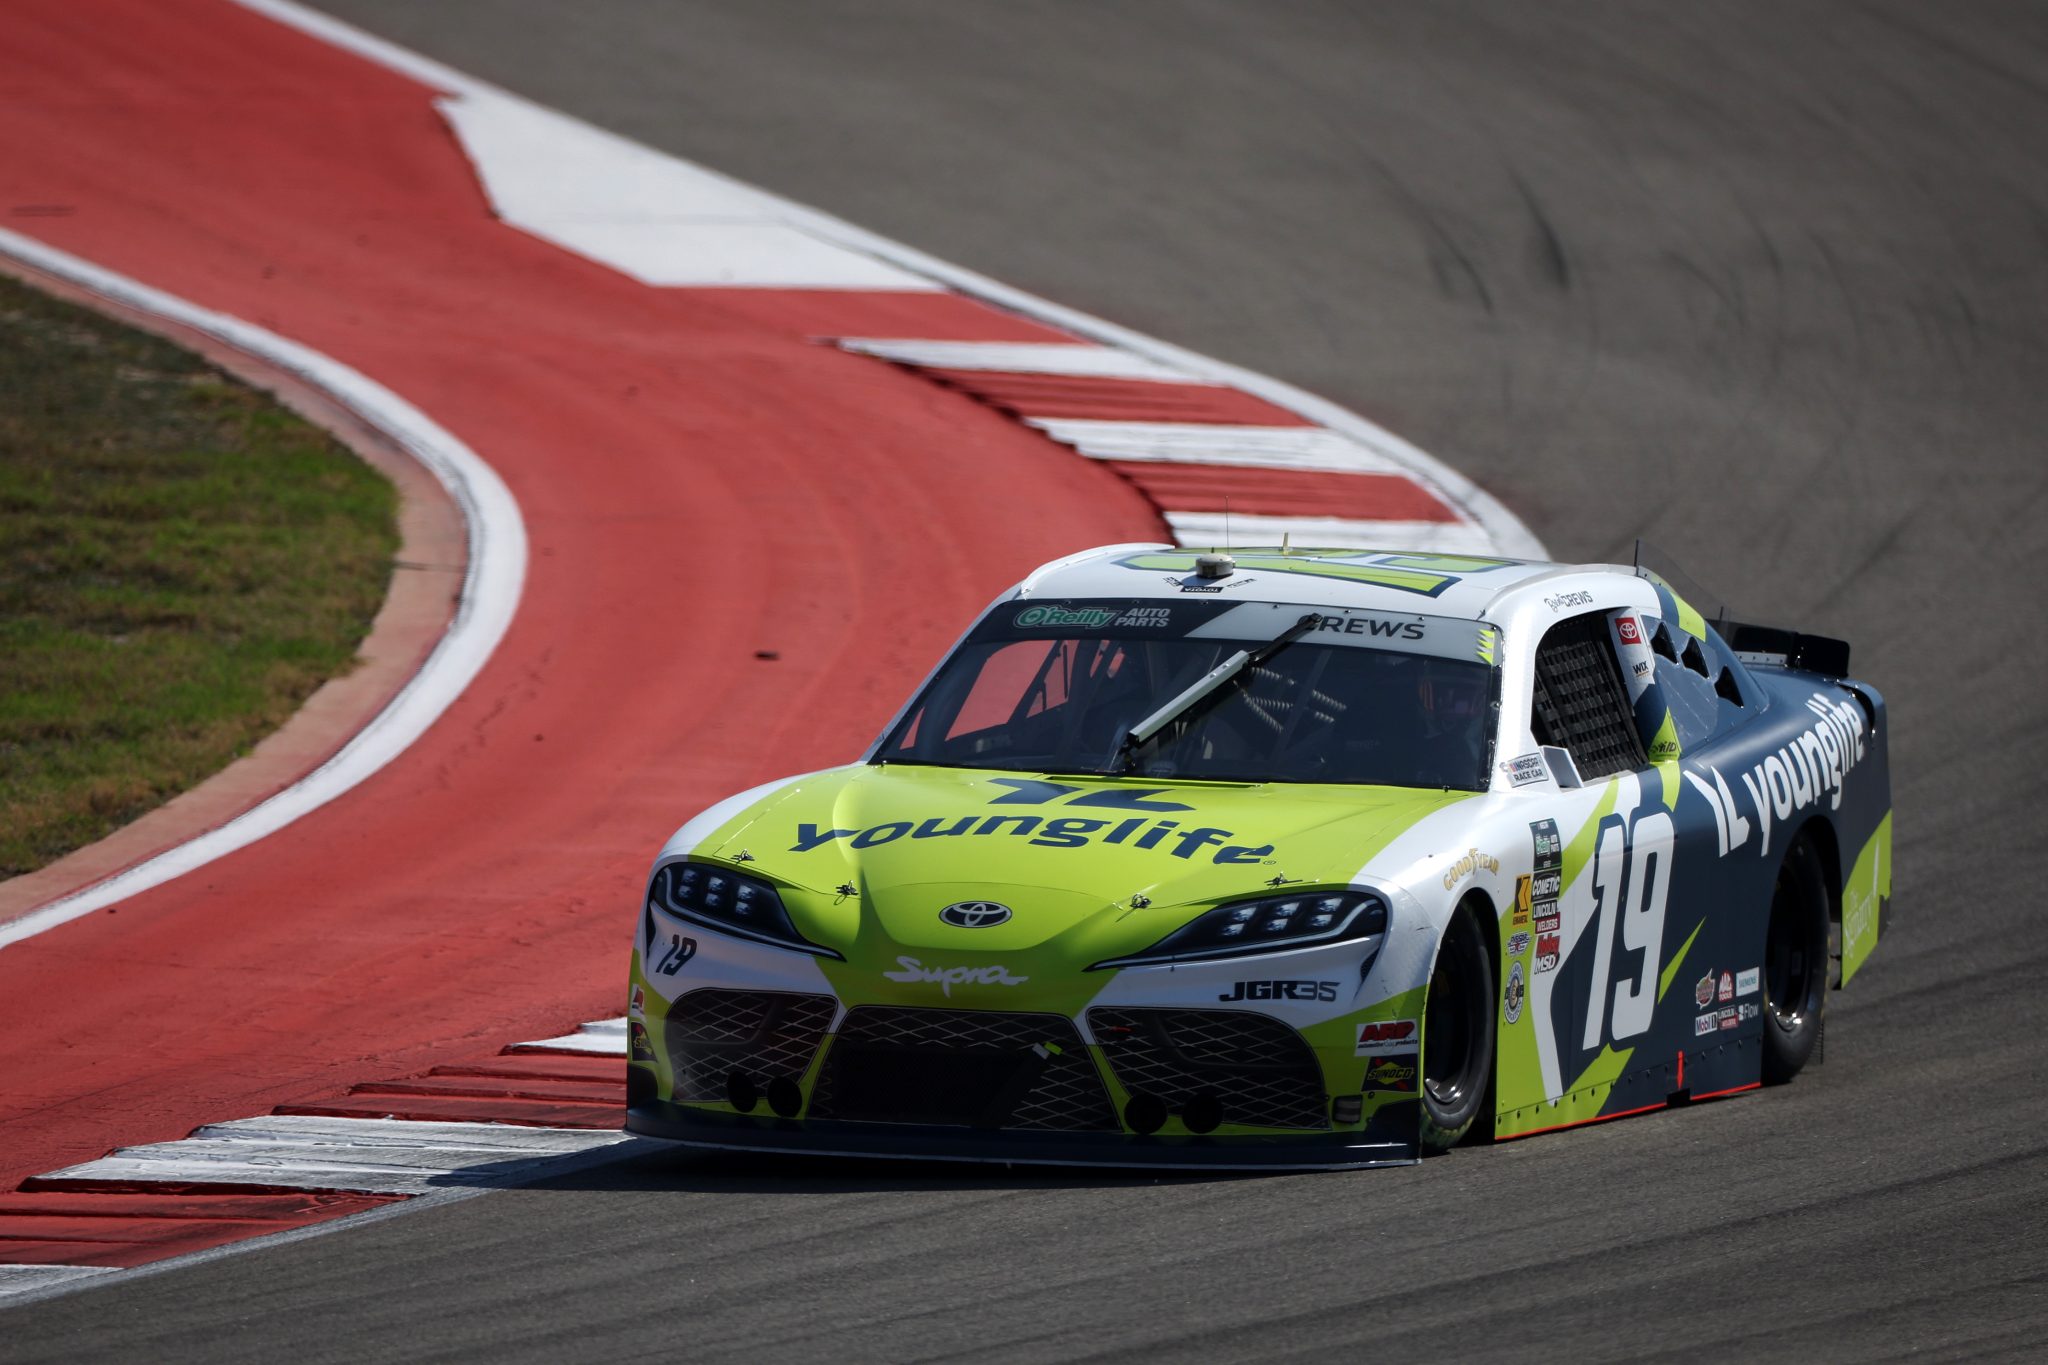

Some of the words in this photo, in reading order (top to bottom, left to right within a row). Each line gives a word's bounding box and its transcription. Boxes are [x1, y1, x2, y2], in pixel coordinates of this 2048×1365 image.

[1562, 590, 1594, 607] CREWS
[1019, 606, 1117, 628] O'Reilly
[1115, 617, 1170, 628] PARTS
[1125, 607, 1171, 618] AUTO
[1633, 661, 1649, 675] WIX
[1513, 770, 1531, 781] RACE
[1531, 769, 1544, 778] CAR
[1742, 693, 1865, 858] younglife
[788, 815, 1275, 865] younglife
[1532, 876, 1560, 896] COMETIC
[1533, 902, 1557, 918] LINCOLN
[1582, 812, 1675, 1051] 19
[655, 934, 697, 976] 19
[1534, 954, 1557, 975] MSD
[883, 956, 1029, 997] Supra
[1359, 1021, 1415, 1042] ARP
[1368, 1067, 1413, 1080] SUNOCO
